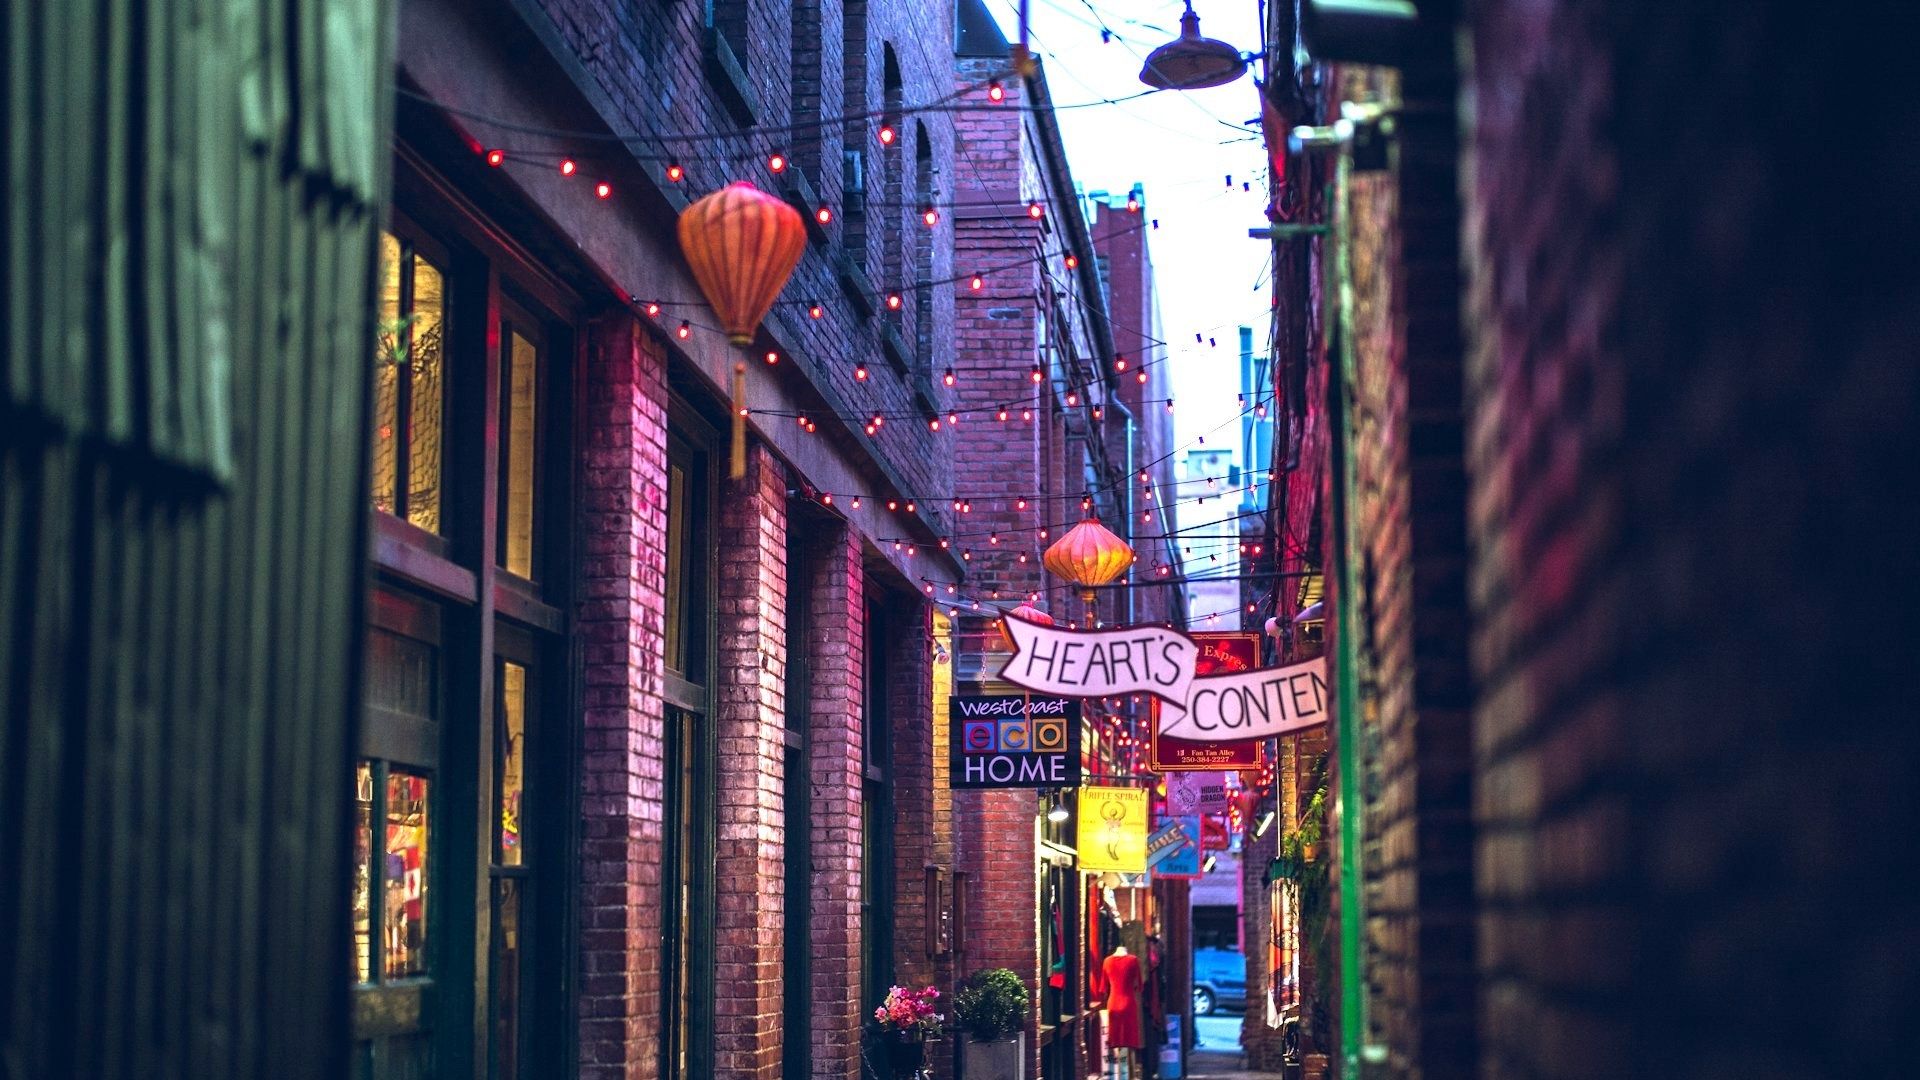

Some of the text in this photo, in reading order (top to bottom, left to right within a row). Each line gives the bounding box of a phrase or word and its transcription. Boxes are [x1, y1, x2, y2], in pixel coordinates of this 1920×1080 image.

[1026, 635, 1184, 686] HEART'S
[969, 723, 1062, 749] eco
[1218, 749, 1236, 757] Alley
[965, 755, 1066, 783] HOME
[1201, 785, 1224, 794] HIDDEN
[1114, 793, 1145, 801] SPIRAL
[1200, 794, 1225, 803] DRAGON
